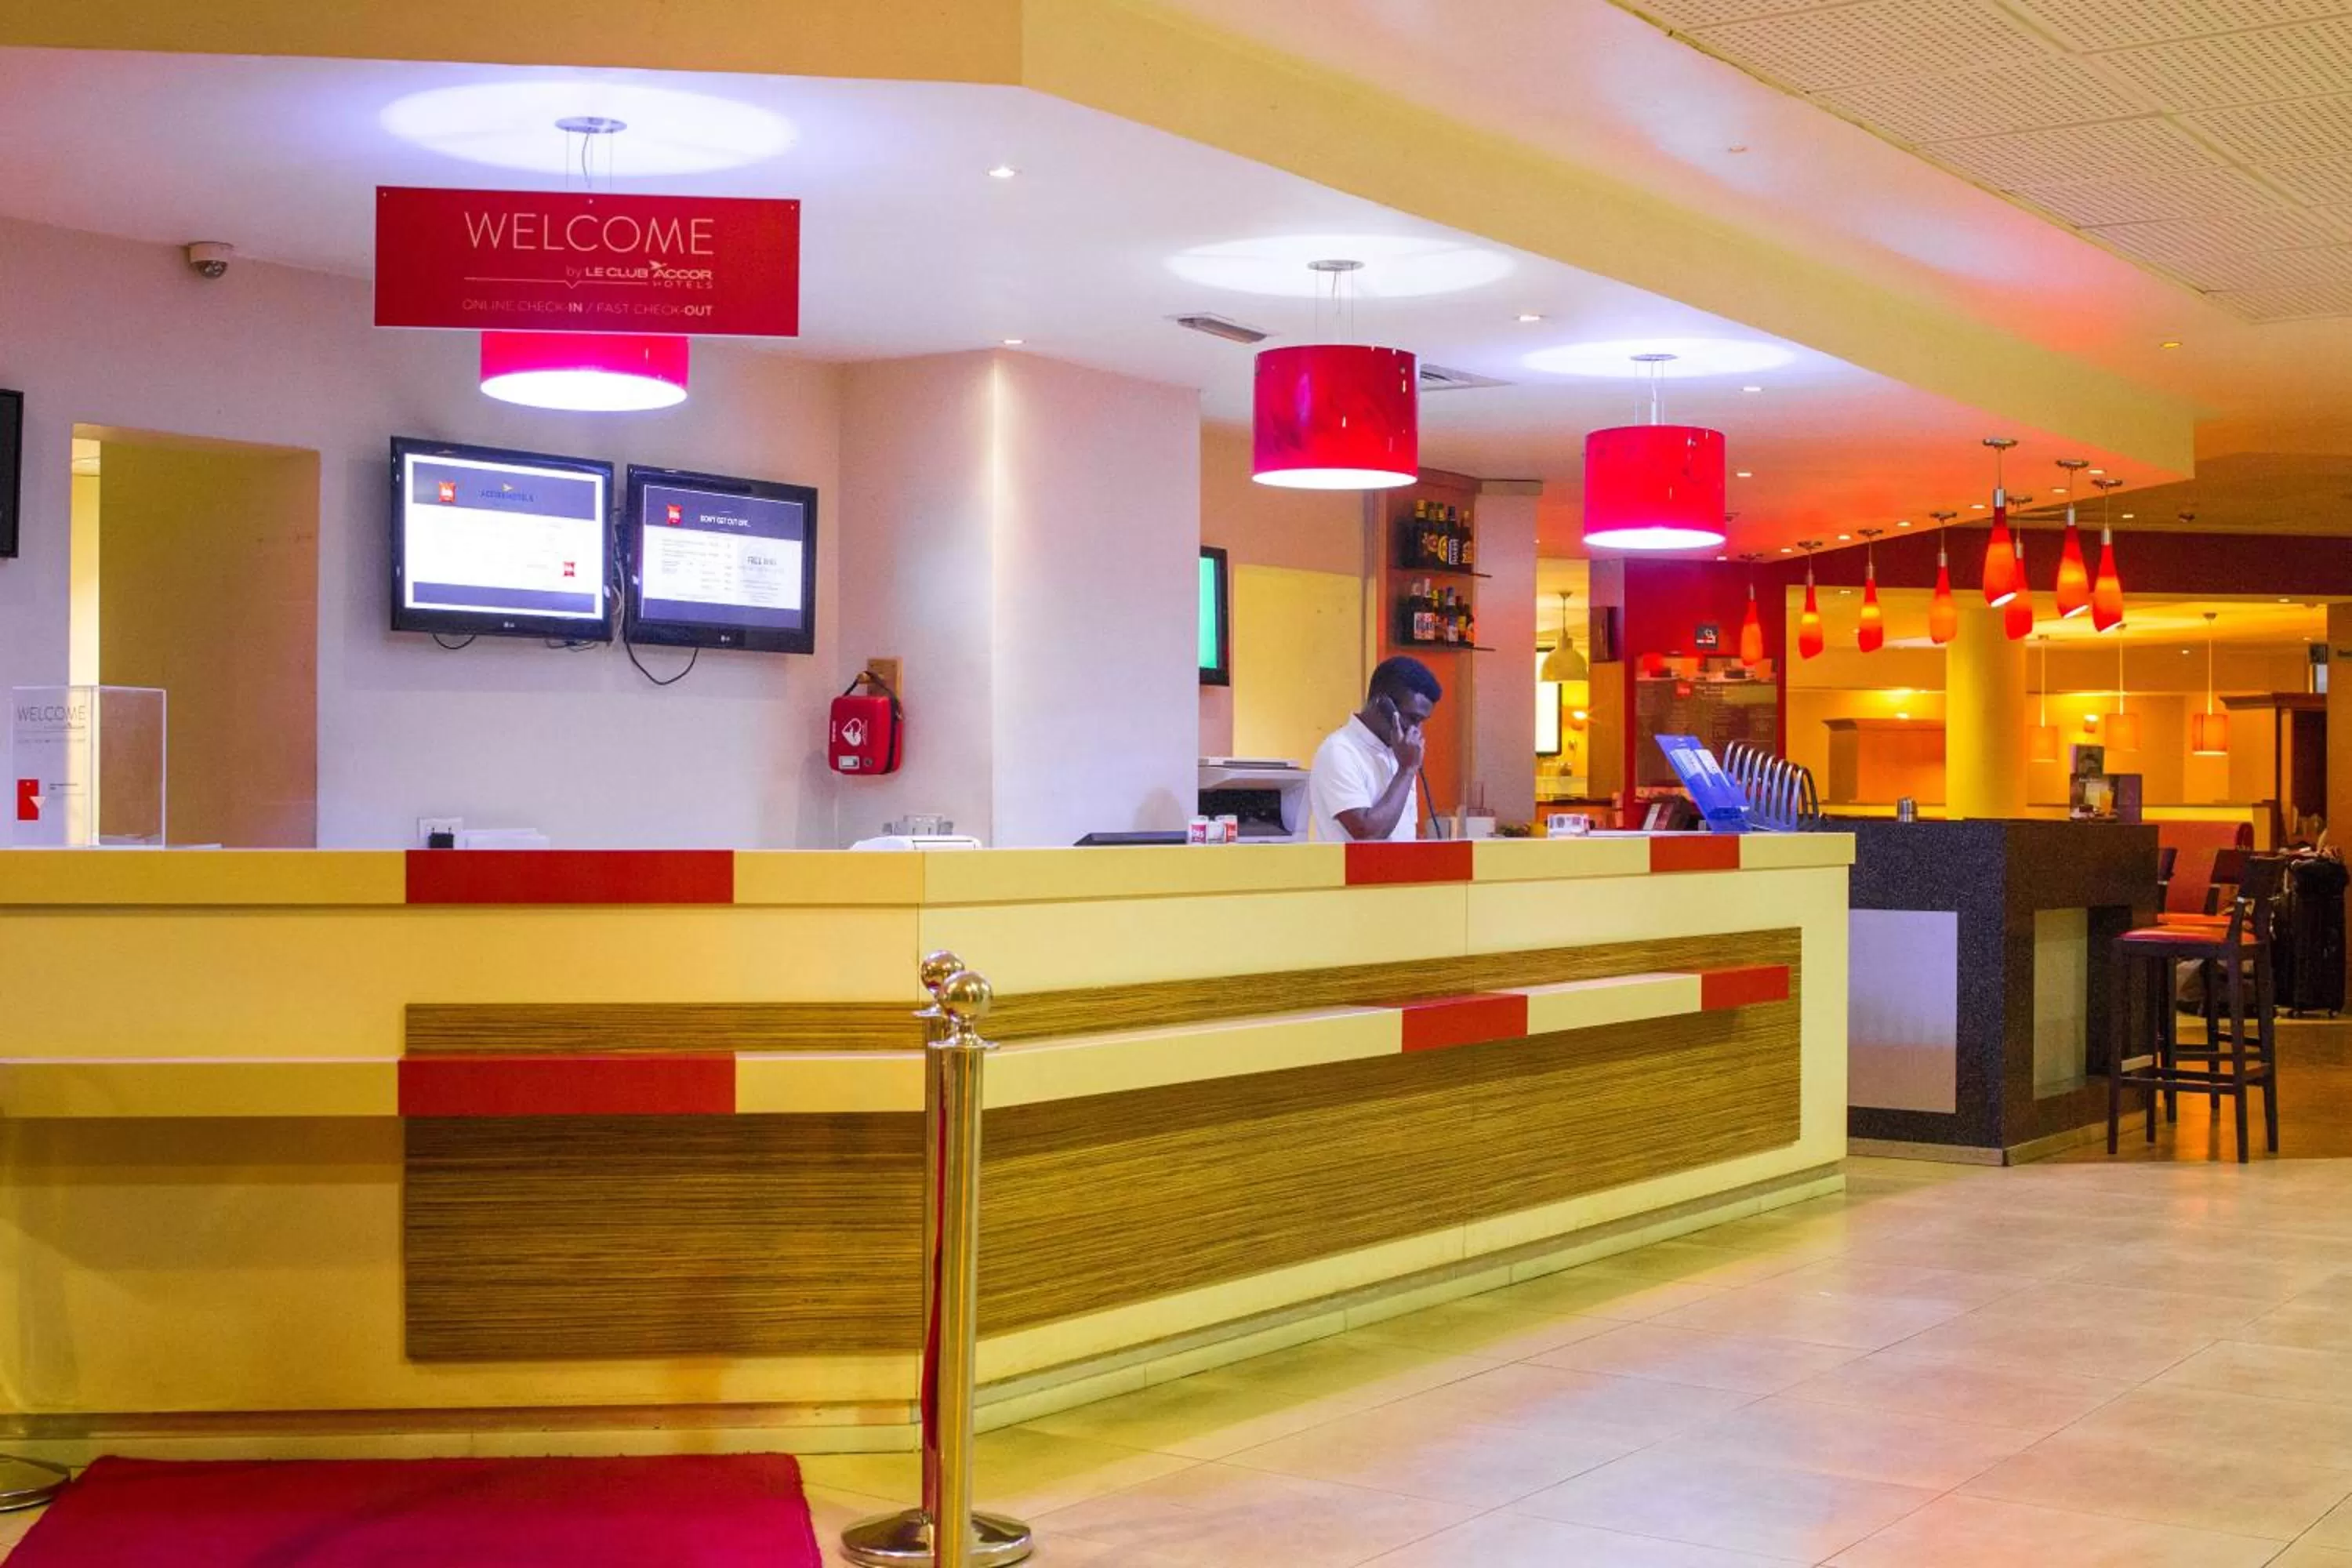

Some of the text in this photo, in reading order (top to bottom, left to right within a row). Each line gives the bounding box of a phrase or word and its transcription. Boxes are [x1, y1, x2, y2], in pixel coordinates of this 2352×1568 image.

[464, 211, 715, 255] WELCOME
[566, 265, 713, 280] by LE CLUB ACCOR
[652, 280, 713, 289] HOTELS
[463, 297, 514, 311] ONLINE
[517, 300, 583, 314] CHECK-IN
[597, 303, 629, 314] FAST
[633, 303, 713, 317] CHECK-OUT
[17, 705, 86, 722] WELCOME
